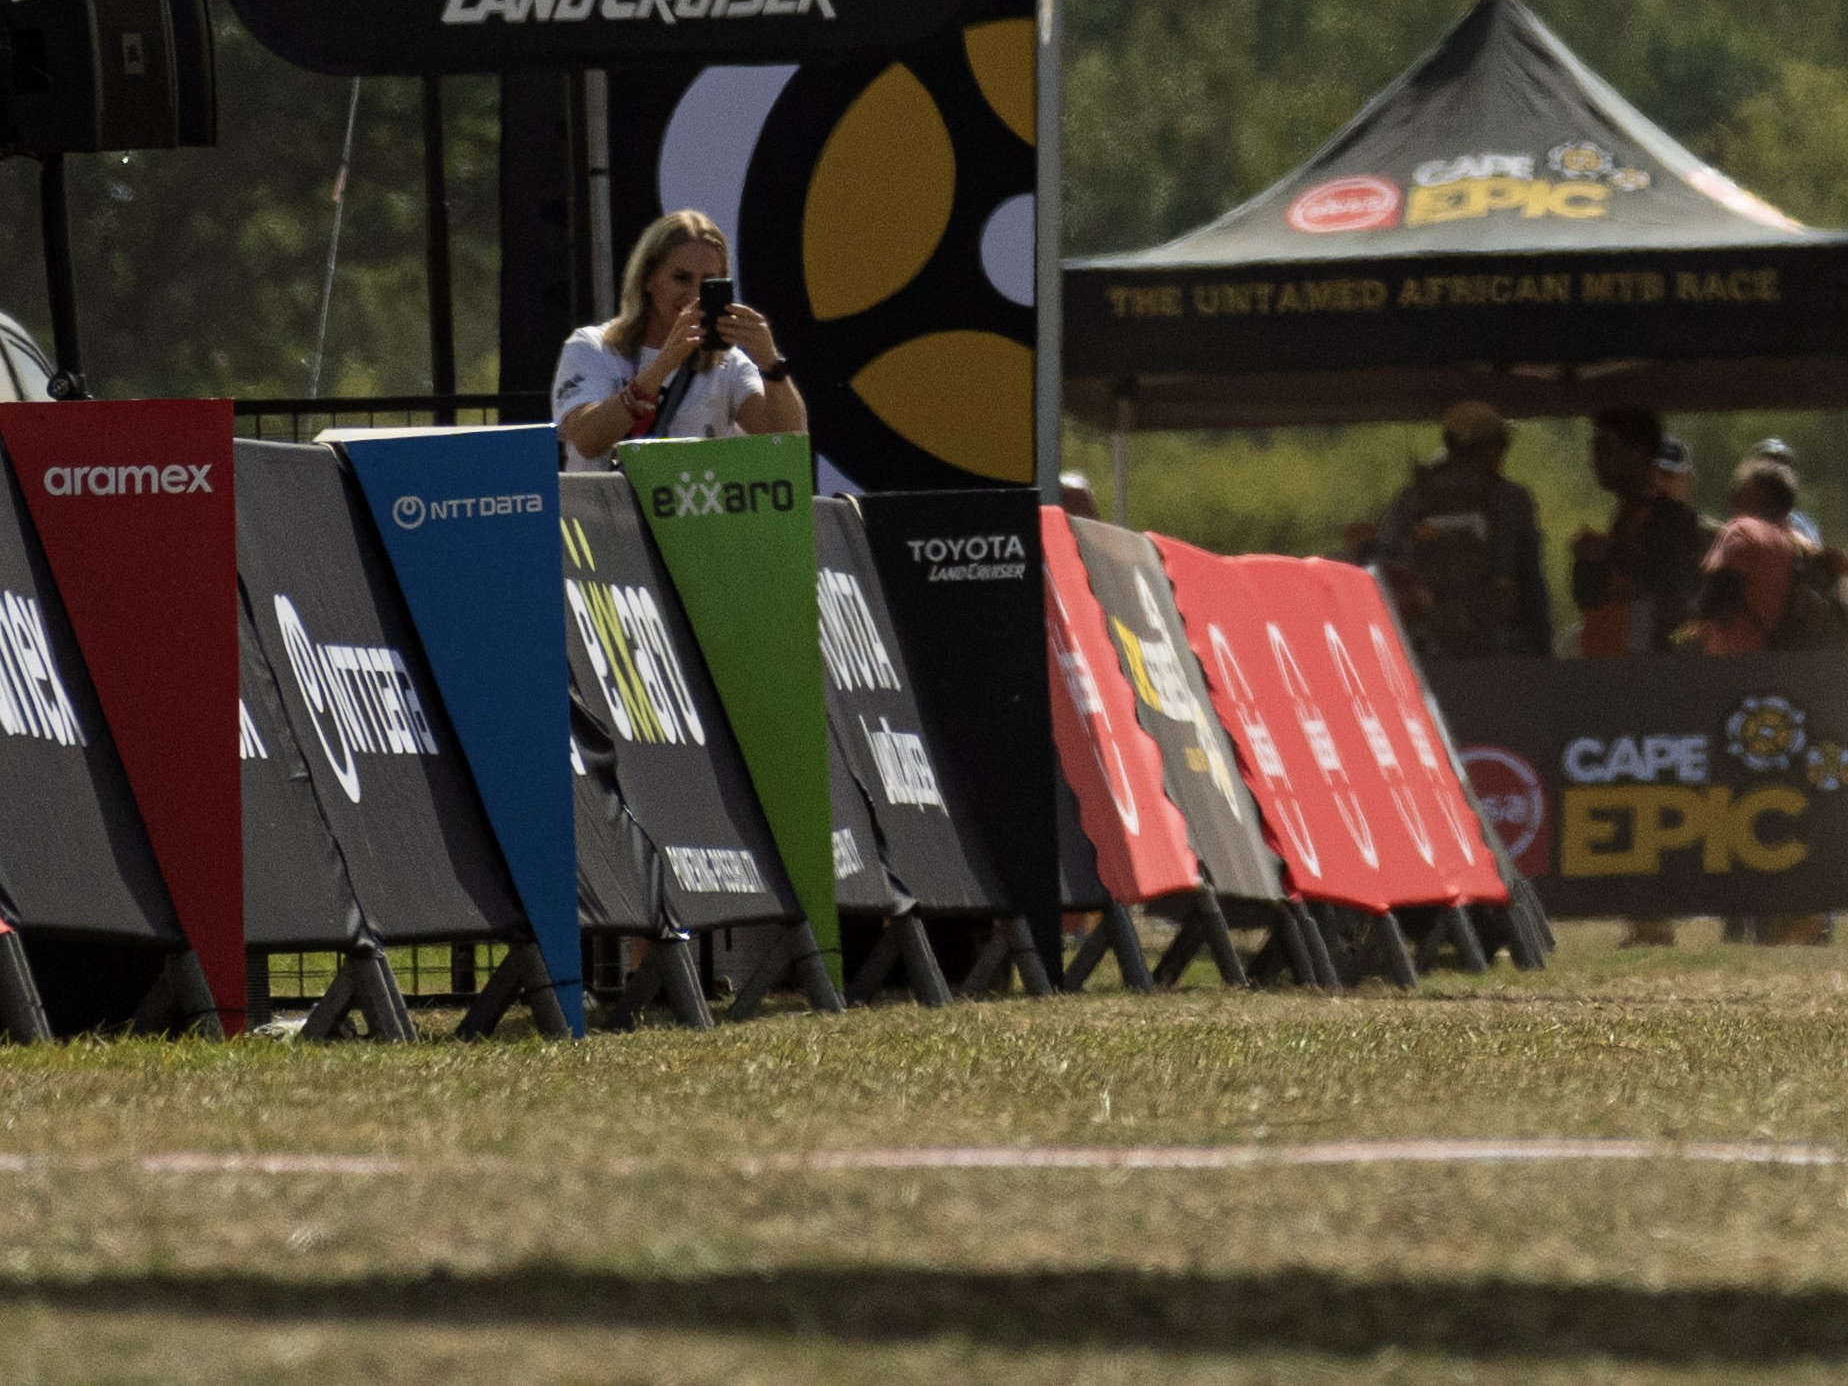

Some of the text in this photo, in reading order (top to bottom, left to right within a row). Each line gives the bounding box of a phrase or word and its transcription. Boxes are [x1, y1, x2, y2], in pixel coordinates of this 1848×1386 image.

[1412, 151, 1537, 188] CAPE
[1404, 175, 1610, 228] EPIC
[1107, 282, 1183, 319] THE
[1191, 278, 1388, 318] UNTAMED
[1396, 272, 1572, 310] AFRICAN
[1674, 266, 1781, 304] RACE
[43, 462, 213, 497] aramex
[651, 470, 795, 519] exxaro
[430, 498, 475, 520] NTT
[907, 534, 1025, 563] TOYOTA
[1562, 733, 1712, 785] CAPE
[1559, 784, 1810, 878] EPIC
